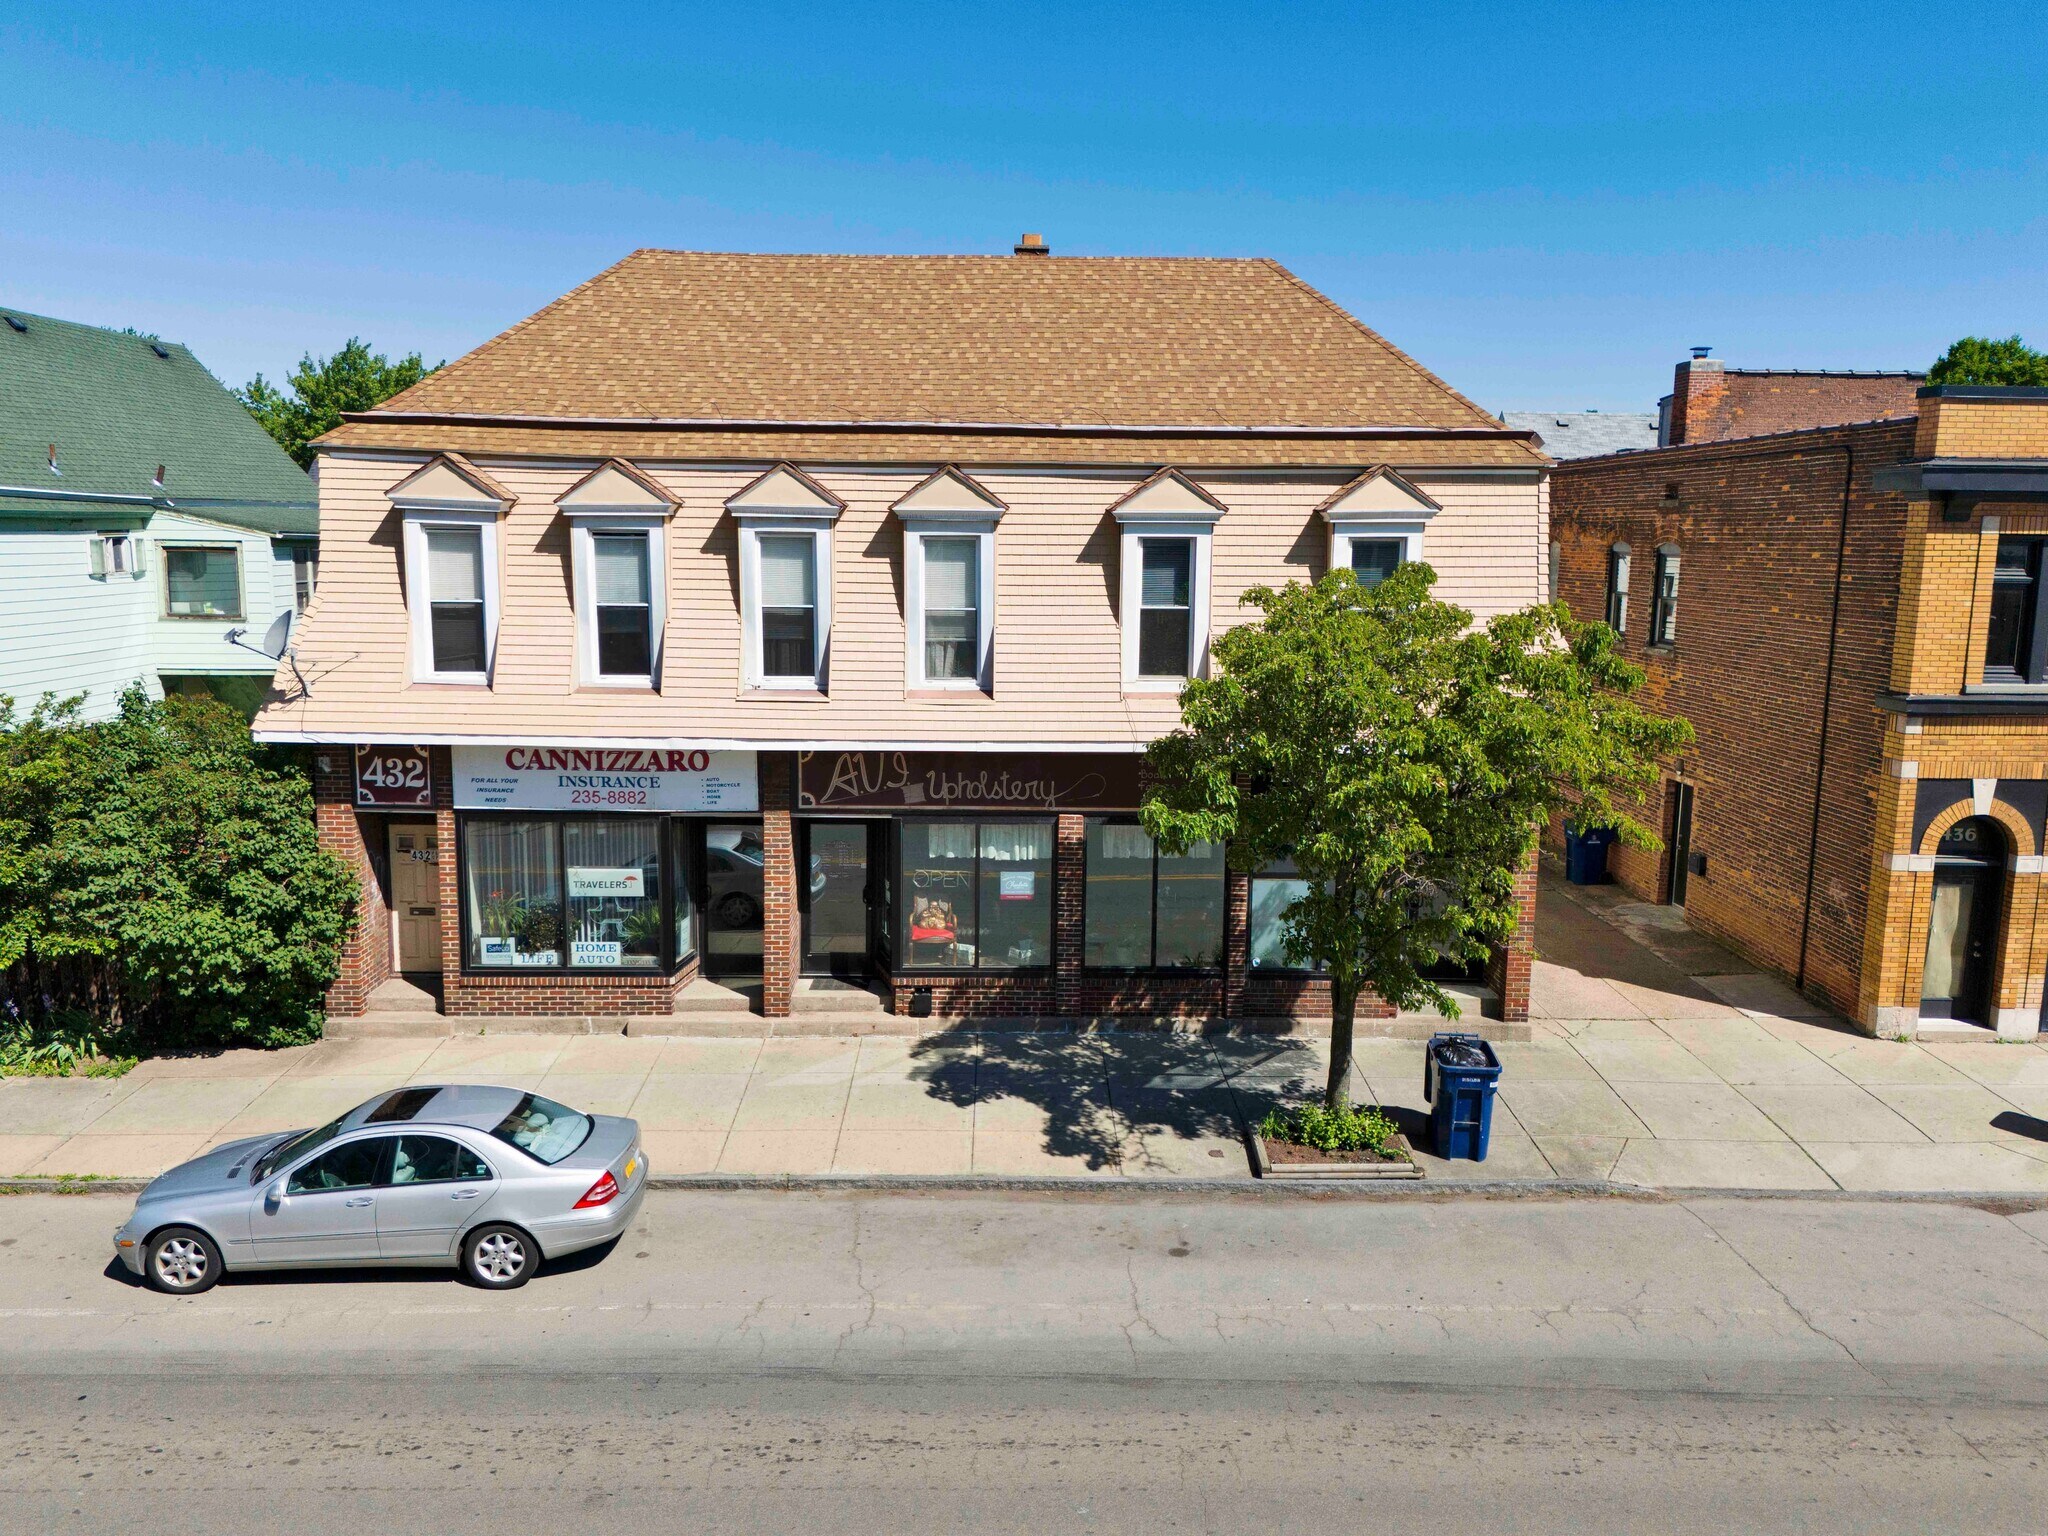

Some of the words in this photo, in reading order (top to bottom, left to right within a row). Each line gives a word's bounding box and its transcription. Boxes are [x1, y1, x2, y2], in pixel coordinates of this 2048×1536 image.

[505, 748, 710, 772] CANNIZZARO
[362, 755, 425, 788] 432
[558, 775, 661, 789] INSURANCE
[926, 770, 1056, 810] Upholstery
[571, 790, 647, 805] 235-8882
[1943, 827, 1977, 841] 436
[411, 850, 431, 860] 432
[573, 880, 628, 889] TRAVELERS
[912, 869, 971, 889] OPEN
[575, 944, 617, 952] HOME
[522, 954, 554, 964] LIFE
[578, 955, 616, 964] AUTO
